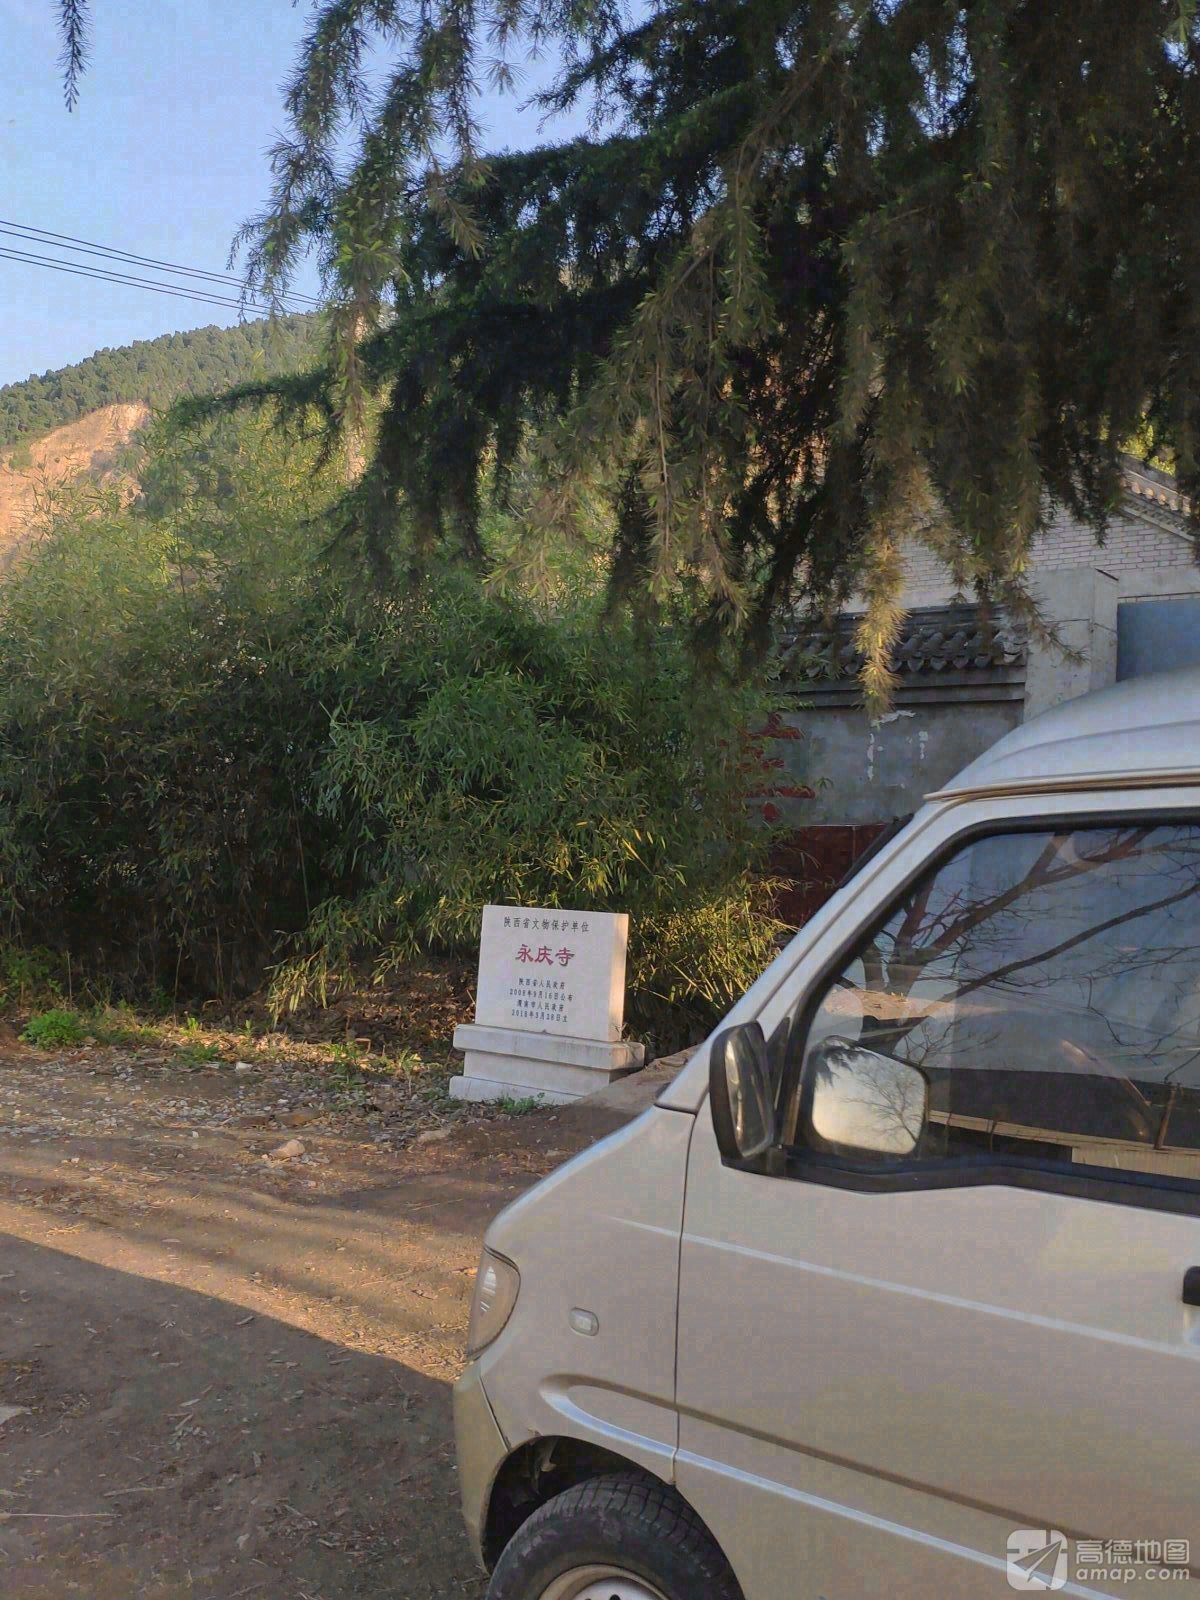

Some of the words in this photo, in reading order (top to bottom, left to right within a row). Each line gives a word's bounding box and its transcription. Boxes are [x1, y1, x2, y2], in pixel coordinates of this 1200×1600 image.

[503, 916, 590, 933] 陕西省文物保护单位
[515, 944, 576, 967] 永庆寺
[518, 978, 565, 990] 陕西省人民政府
